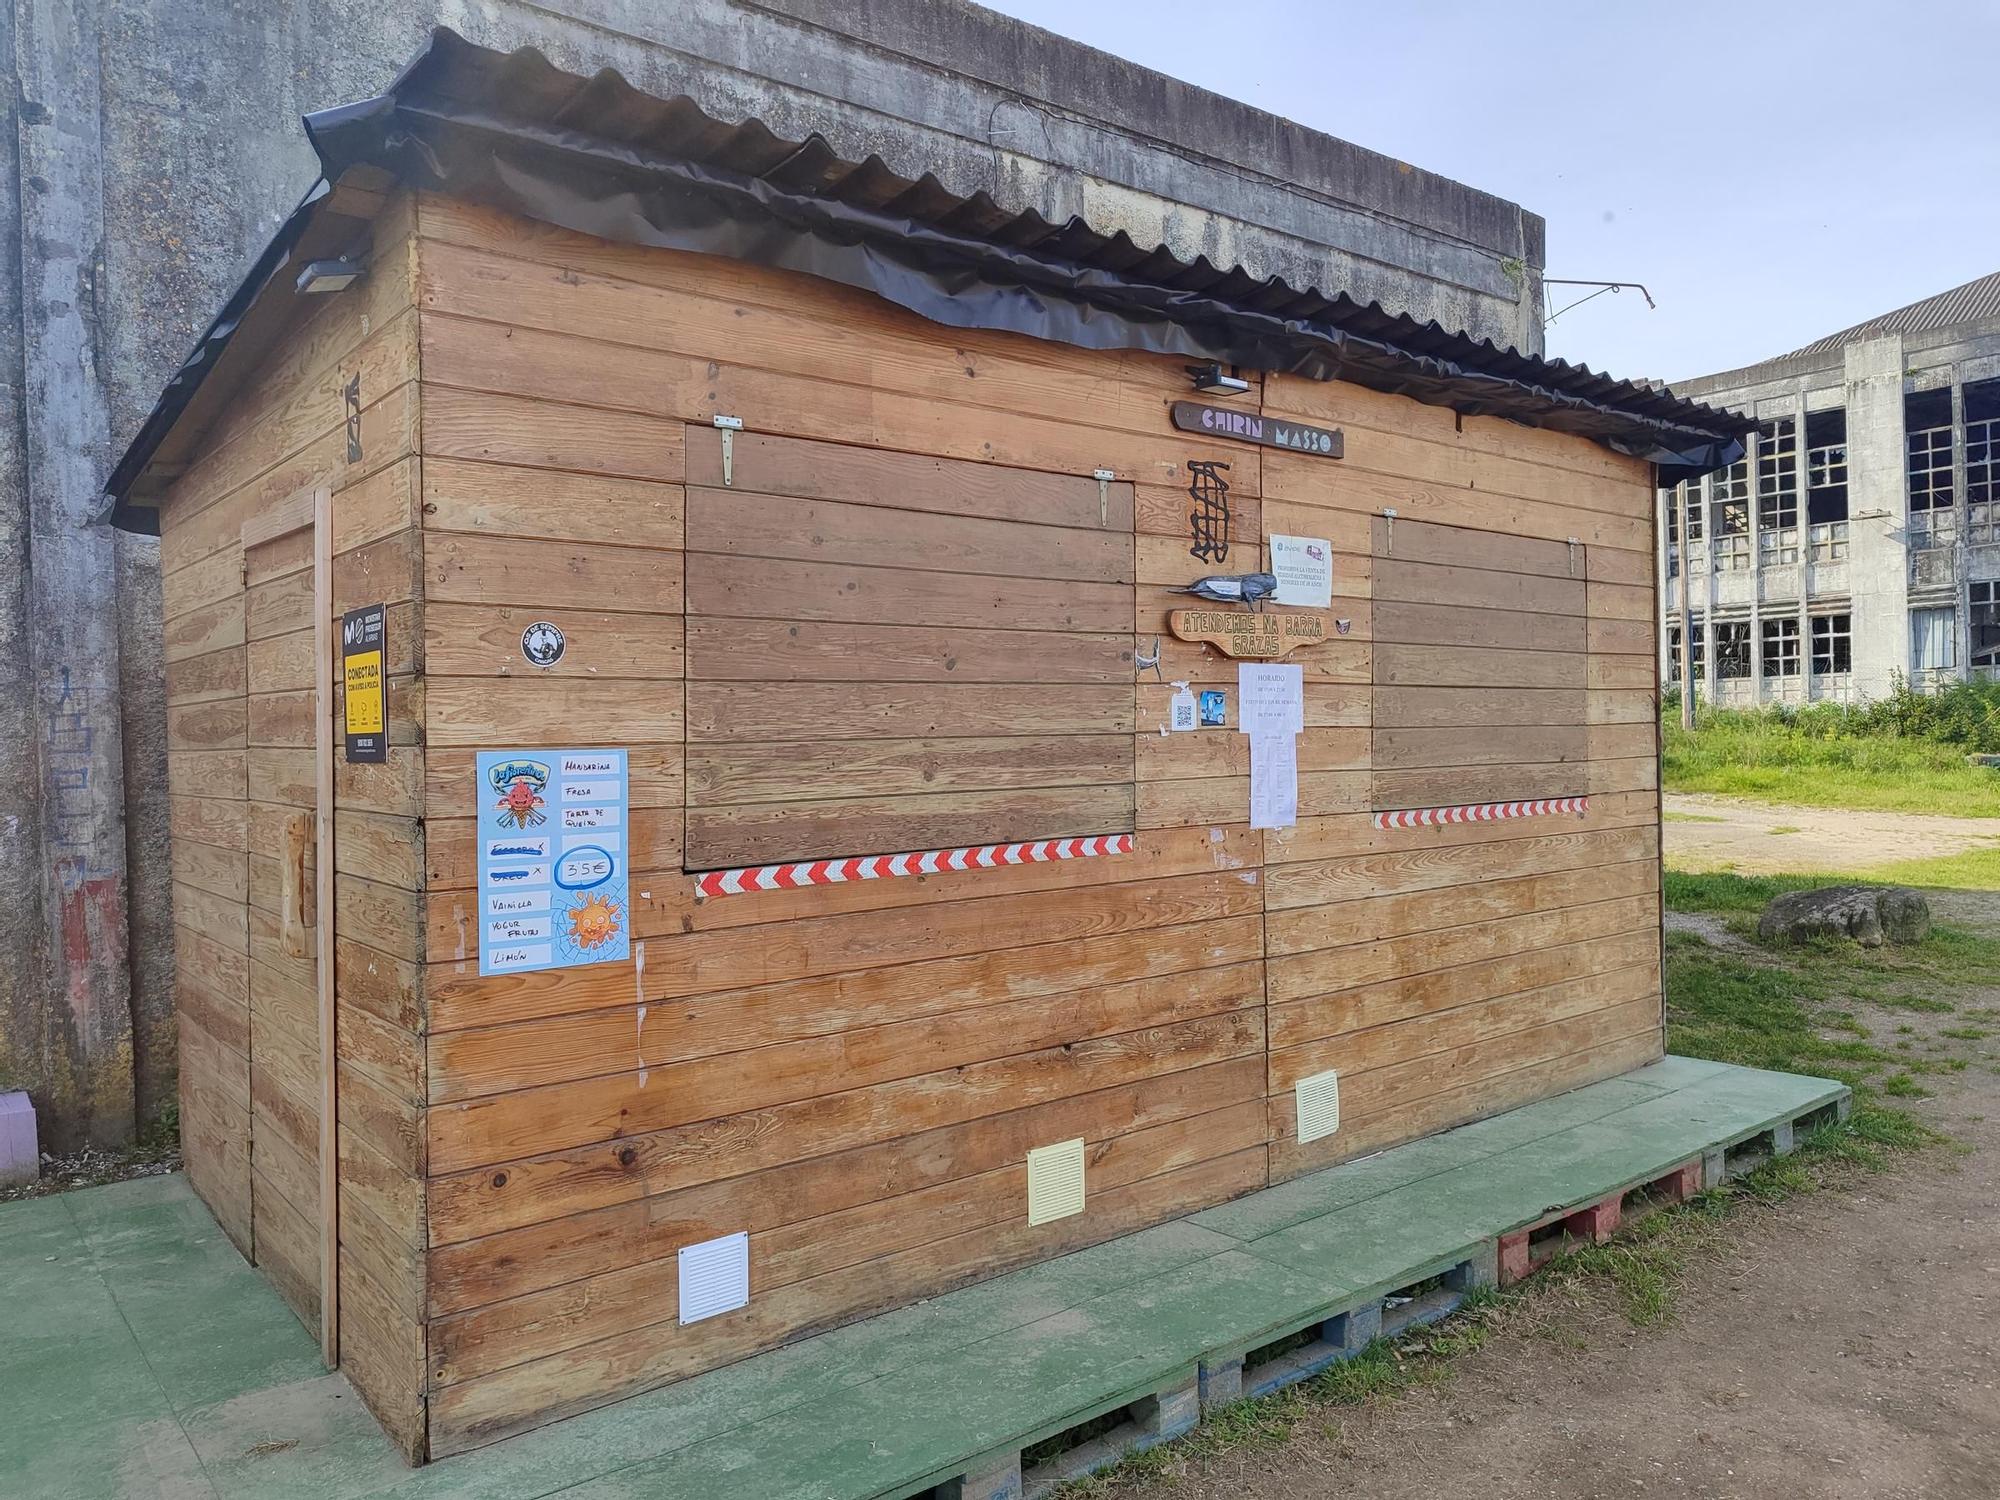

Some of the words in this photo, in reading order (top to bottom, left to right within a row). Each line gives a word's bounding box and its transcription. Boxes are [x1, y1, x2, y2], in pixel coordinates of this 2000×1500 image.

[1275, 426, 1331, 452] MASSO
[1183, 612, 1256, 634] ATENDEMOS
[1262, 614, 1279, 635] NA
[1285, 615, 1323, 637] BARRA
[1232, 634, 1280, 655] GRAZAS
